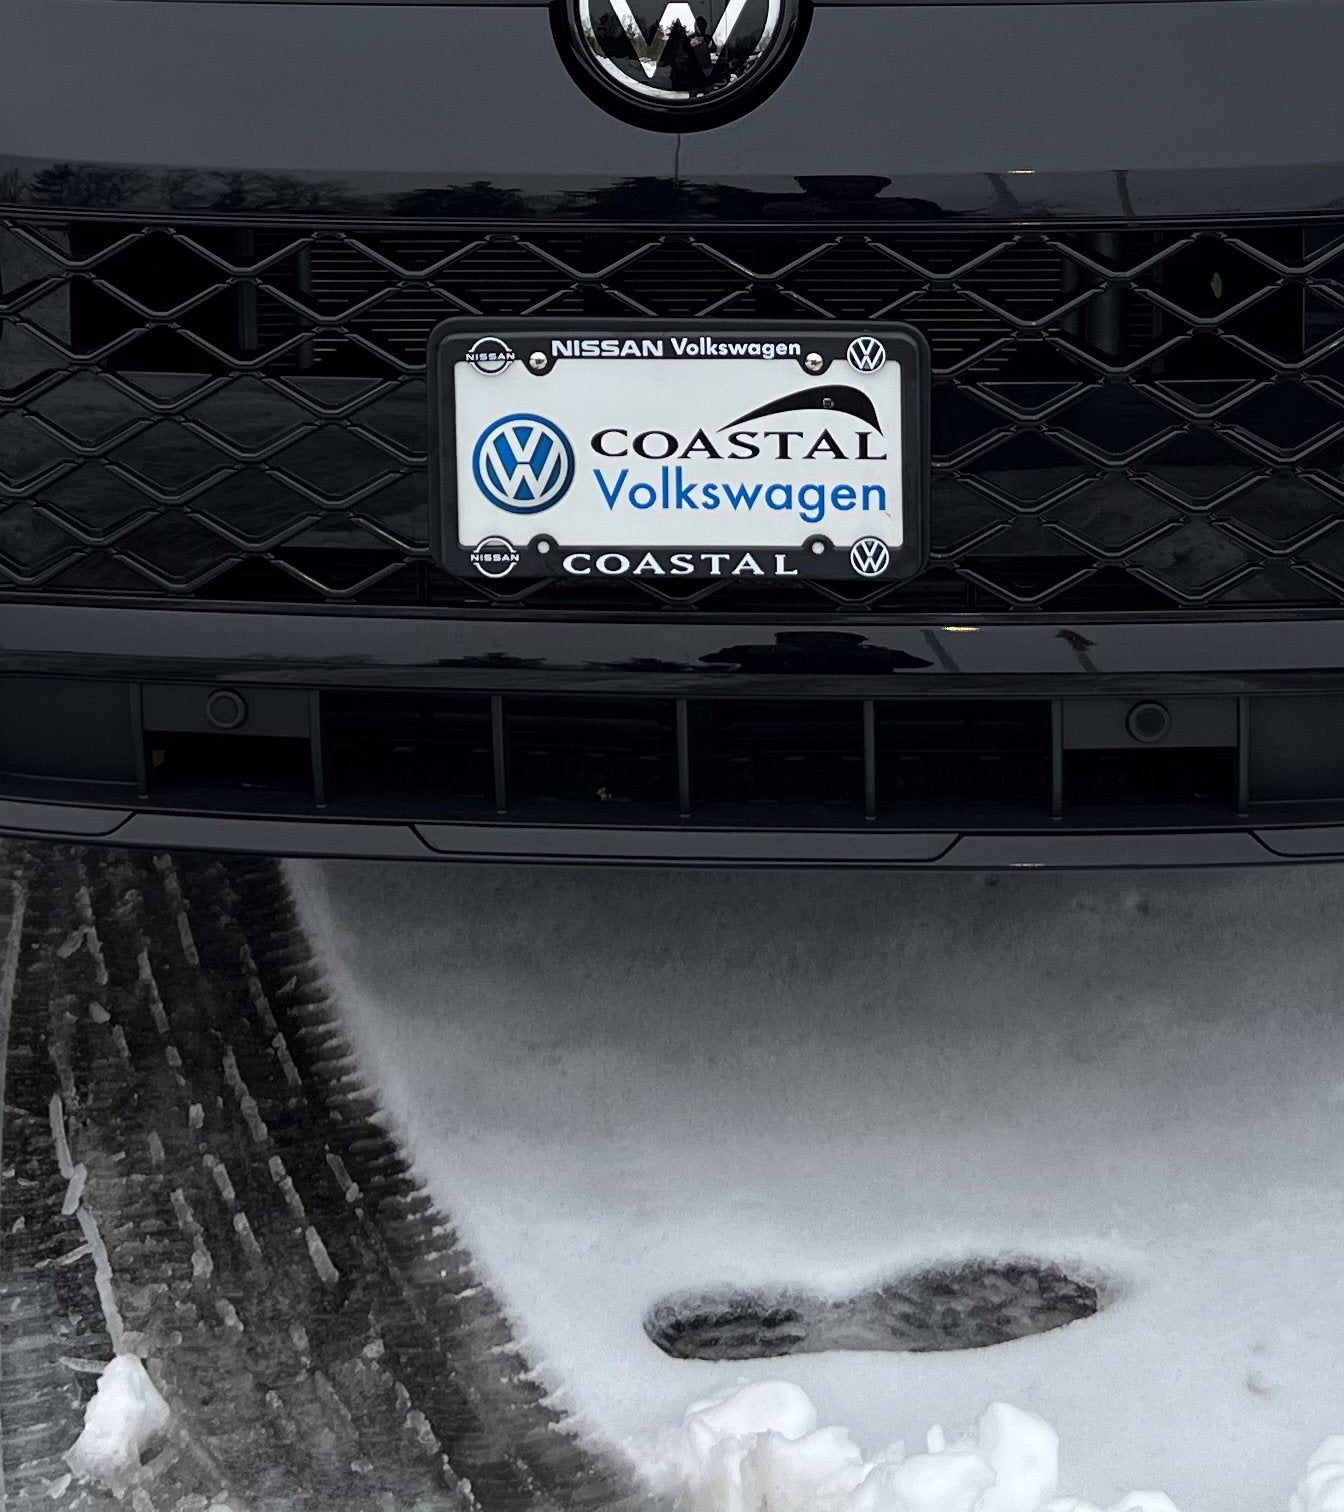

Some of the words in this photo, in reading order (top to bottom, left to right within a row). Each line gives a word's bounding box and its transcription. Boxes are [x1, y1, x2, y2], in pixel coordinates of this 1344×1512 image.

[465, 352, 516, 361] NISSAN
[551, 339, 664, 357] NISSAN
[670, 336, 801, 363] Volkswagen
[589, 427, 888, 461] COASTAL
[593, 465, 886, 524] Volkswagen
[470, 553, 520, 562] NISSAN
[562, 552, 798, 575] COASTAL
